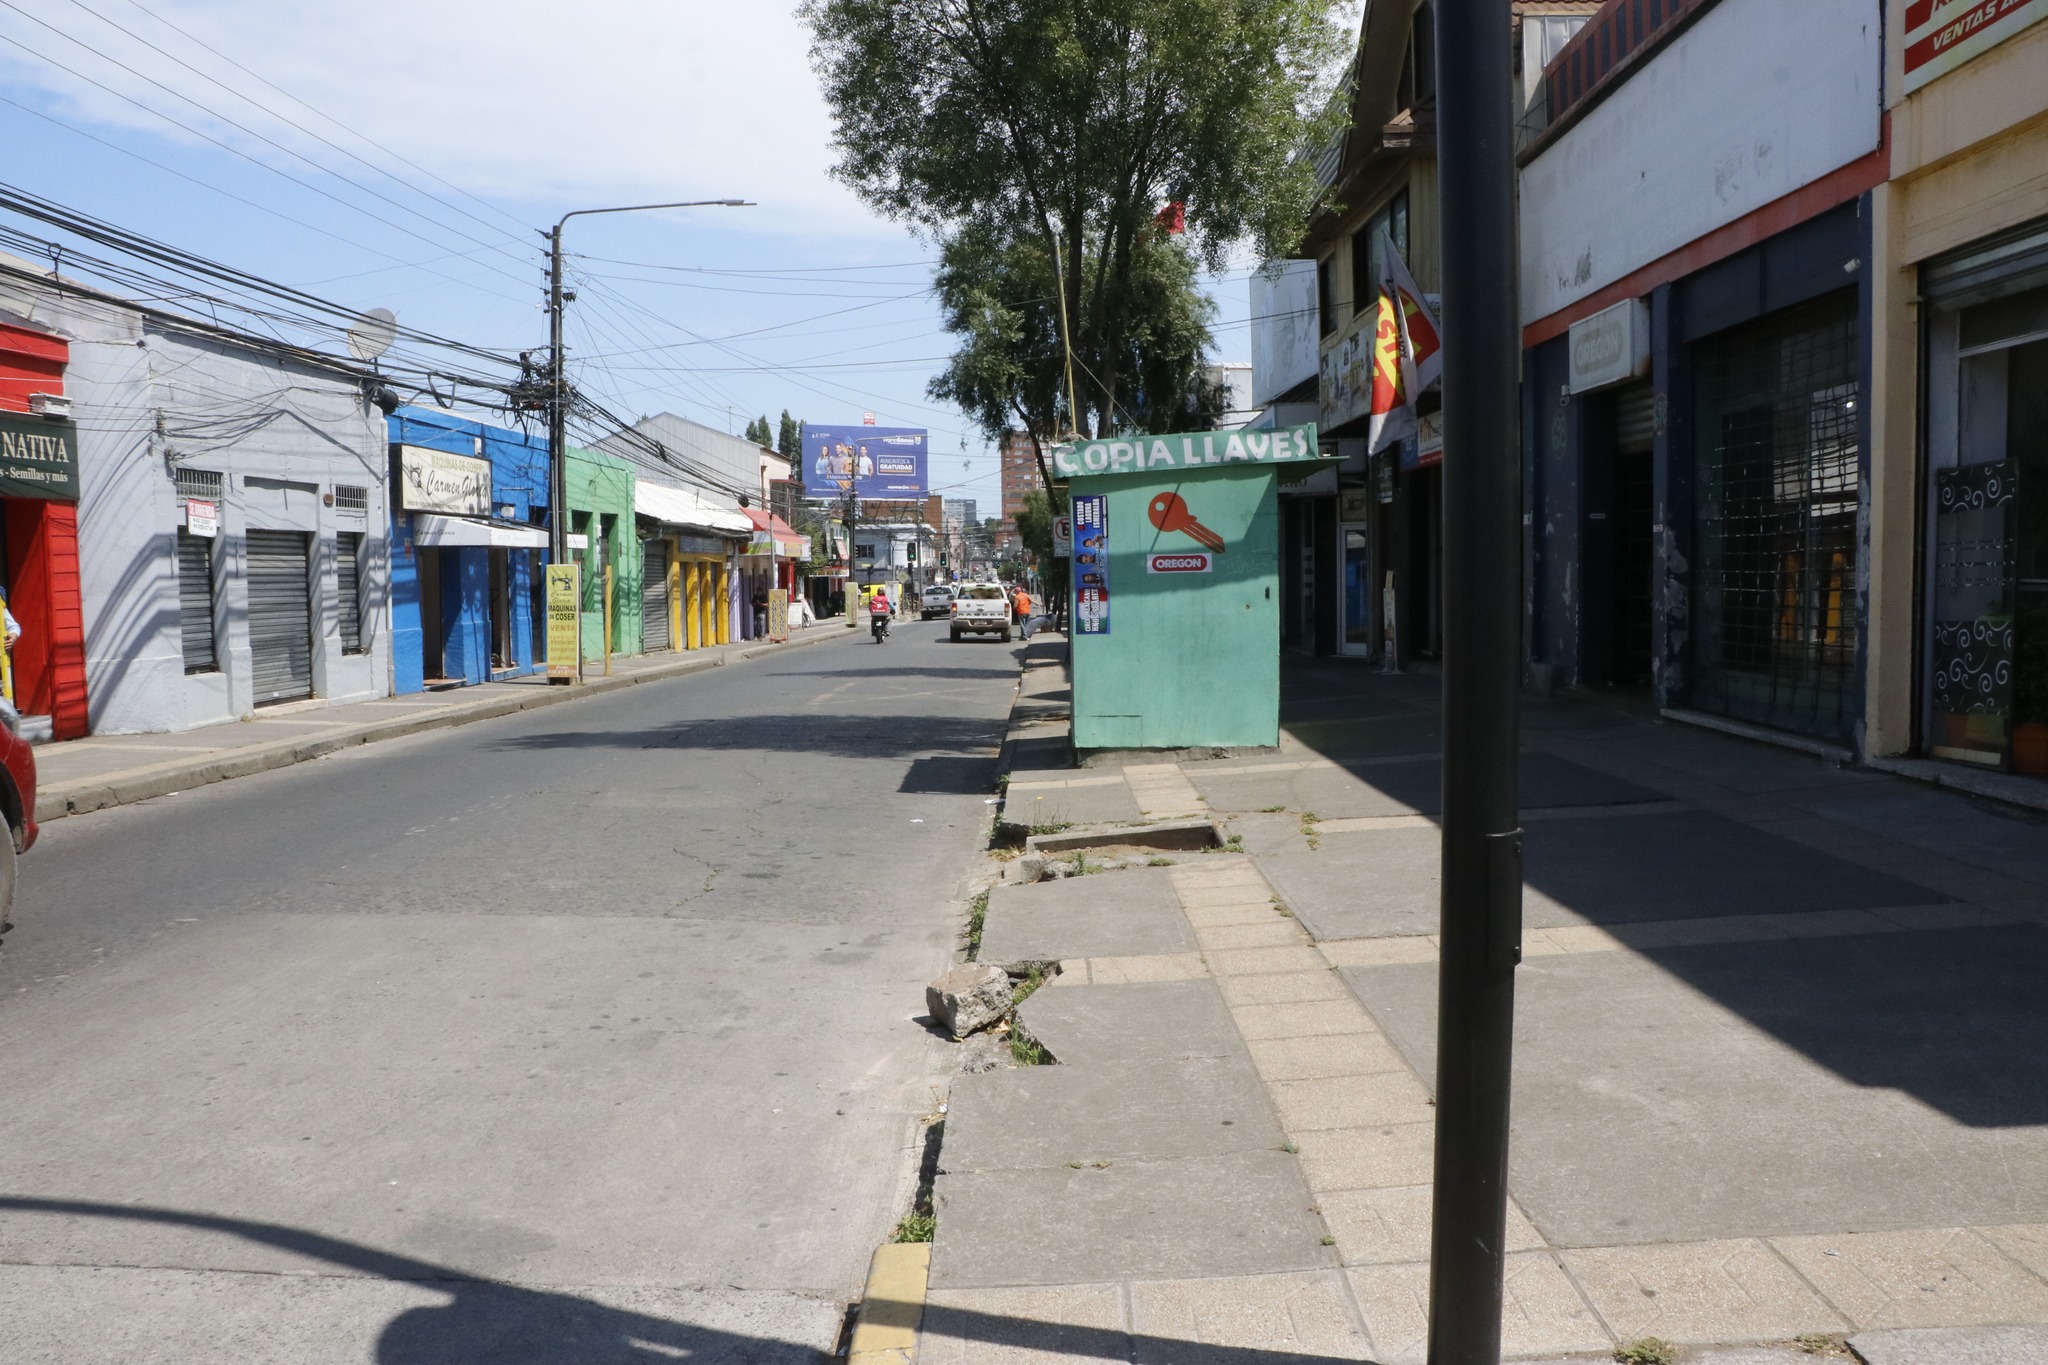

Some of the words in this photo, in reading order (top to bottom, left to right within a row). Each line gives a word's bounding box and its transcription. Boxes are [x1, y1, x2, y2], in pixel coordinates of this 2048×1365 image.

[1933, 2, 1996, 50] VENTAS
[1576, 330, 1619, 367] OREGON
[1, 431, 70, 463] NATIVA
[1055, 440, 1176, 473] COPIA
[1182, 429, 1308, 465] LLAVES
[10, 466, 45, 481] Semillas
[46, 472, 51, 484] y
[52, 470, 69, 482] más
[431, 454, 458, 470] MAQUINAS
[459, 460, 466, 472] DE
[427, 469, 460, 496] Carmen
[1076, 501, 1085, 525] COSTADO
[1092, 498, 1101, 529] ESMERALDA
[1155, 558, 1202, 569] OREGON
[548, 604, 577, 612] MAQUINAS
[555, 613, 576, 621] COSER
